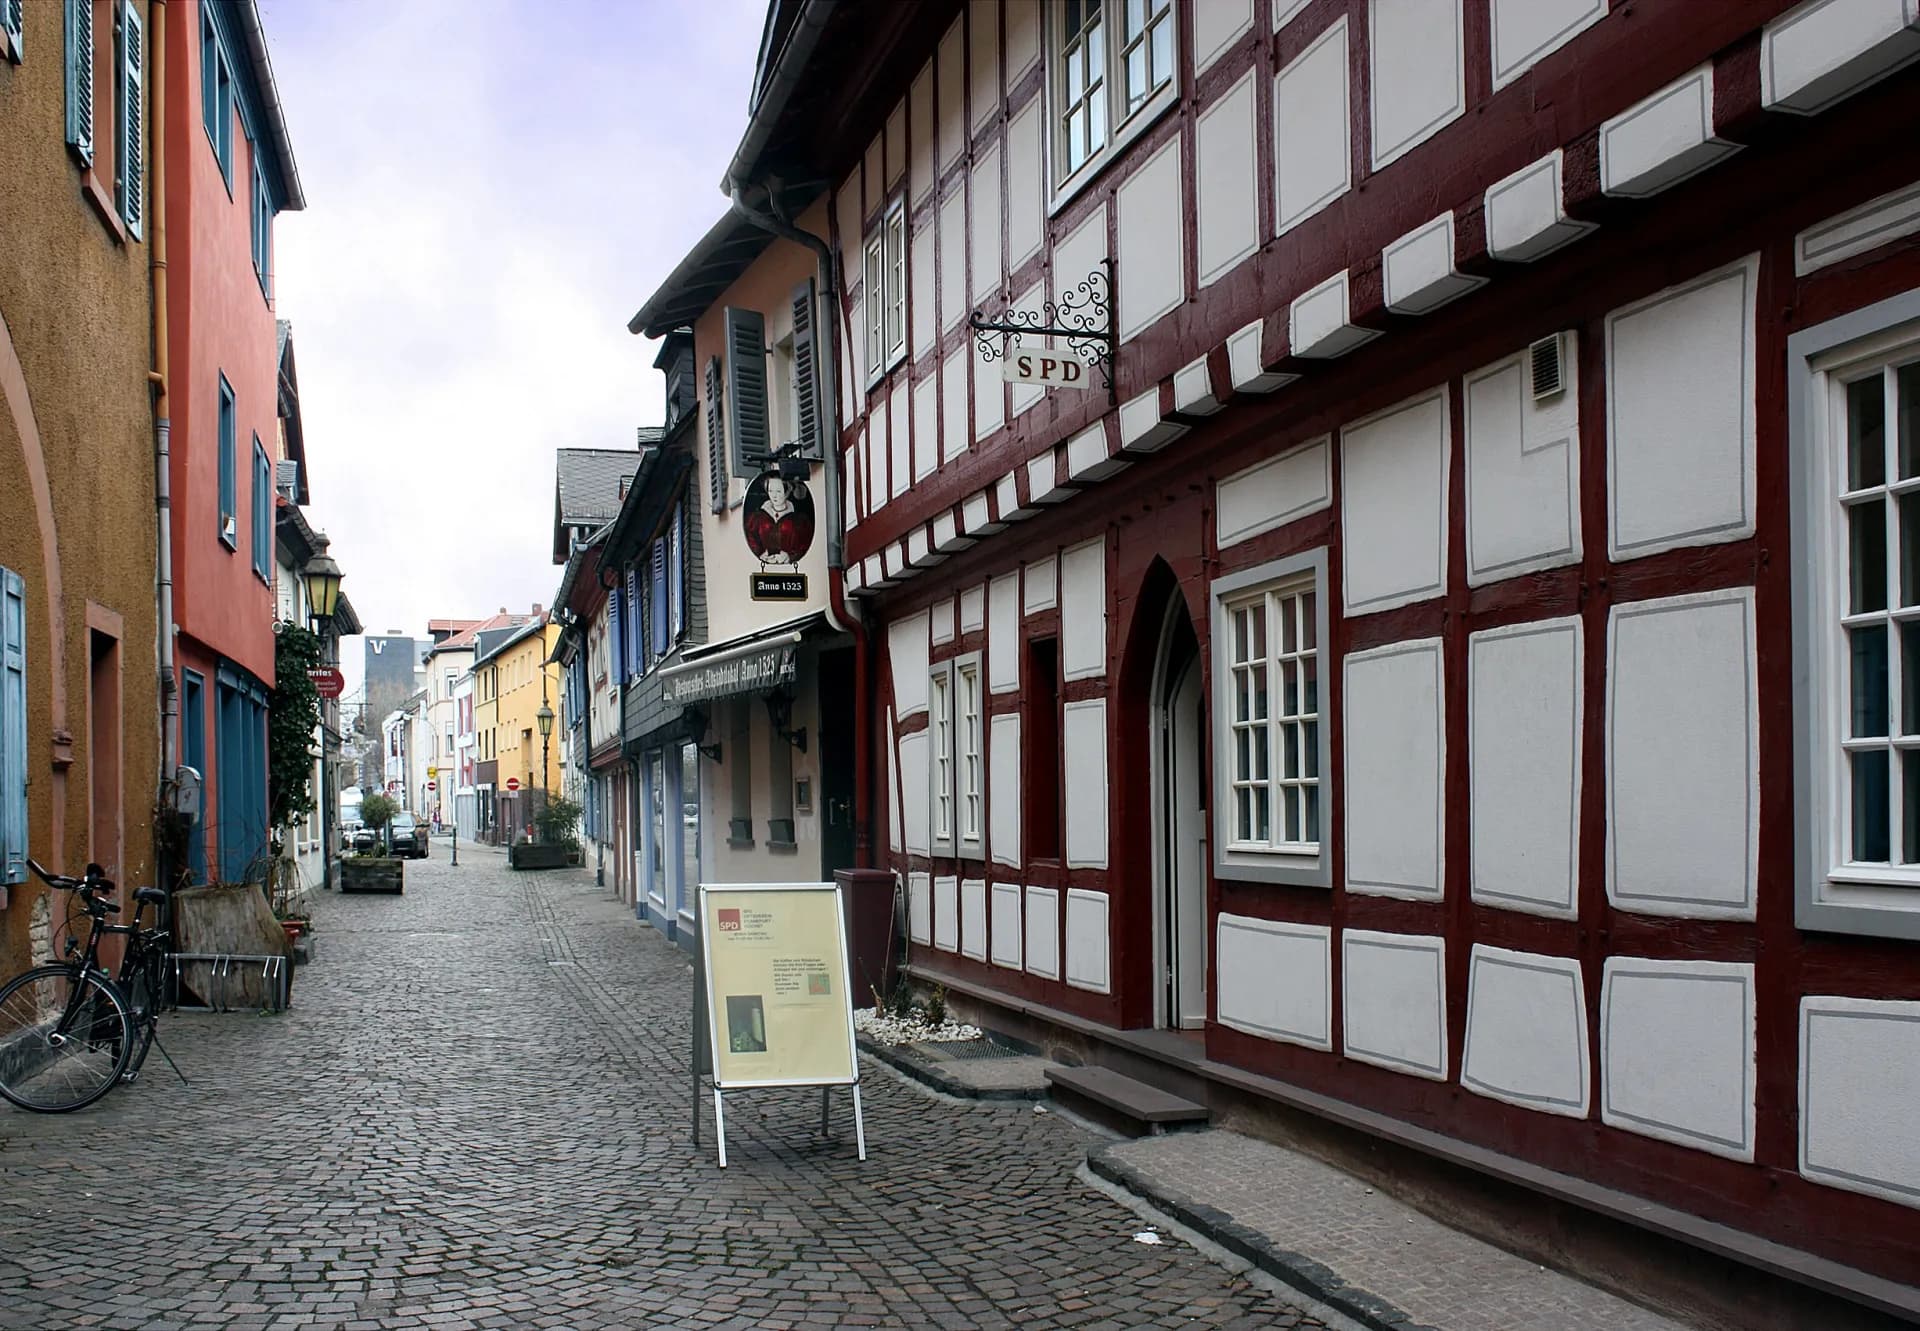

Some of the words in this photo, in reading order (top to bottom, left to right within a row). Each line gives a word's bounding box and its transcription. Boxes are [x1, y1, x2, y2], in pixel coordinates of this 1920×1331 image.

[1017, 355, 1081, 382] SPD
[757, 581, 780, 591] Anno
[781, 582, 802, 591] 1525
[758, 654, 775, 677] 1525
[719, 921, 739, 930] SPD
